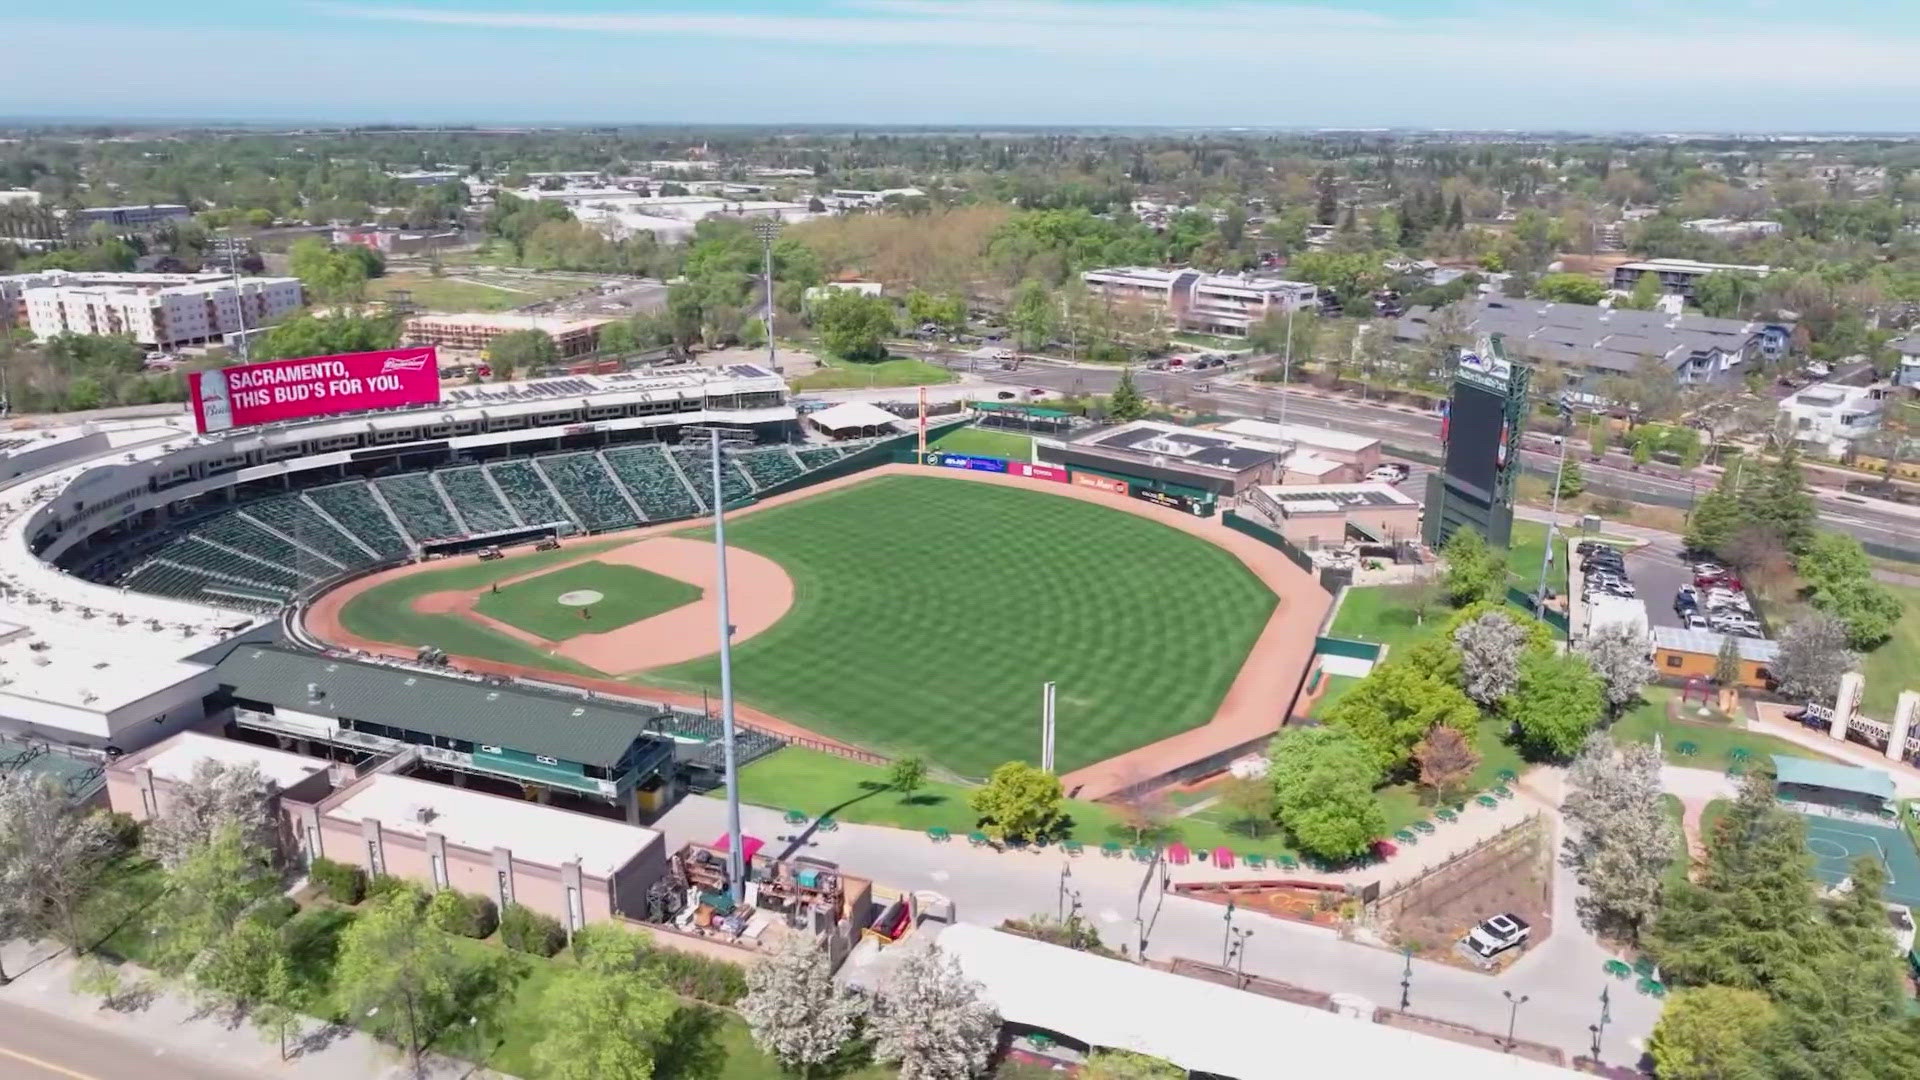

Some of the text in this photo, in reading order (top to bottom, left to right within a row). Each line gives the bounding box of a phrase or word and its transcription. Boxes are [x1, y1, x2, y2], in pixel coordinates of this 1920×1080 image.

[229, 361, 349, 389] SACRAMENTO,
[232, 375, 404, 410] THIS BUD'S FOR YOU.
